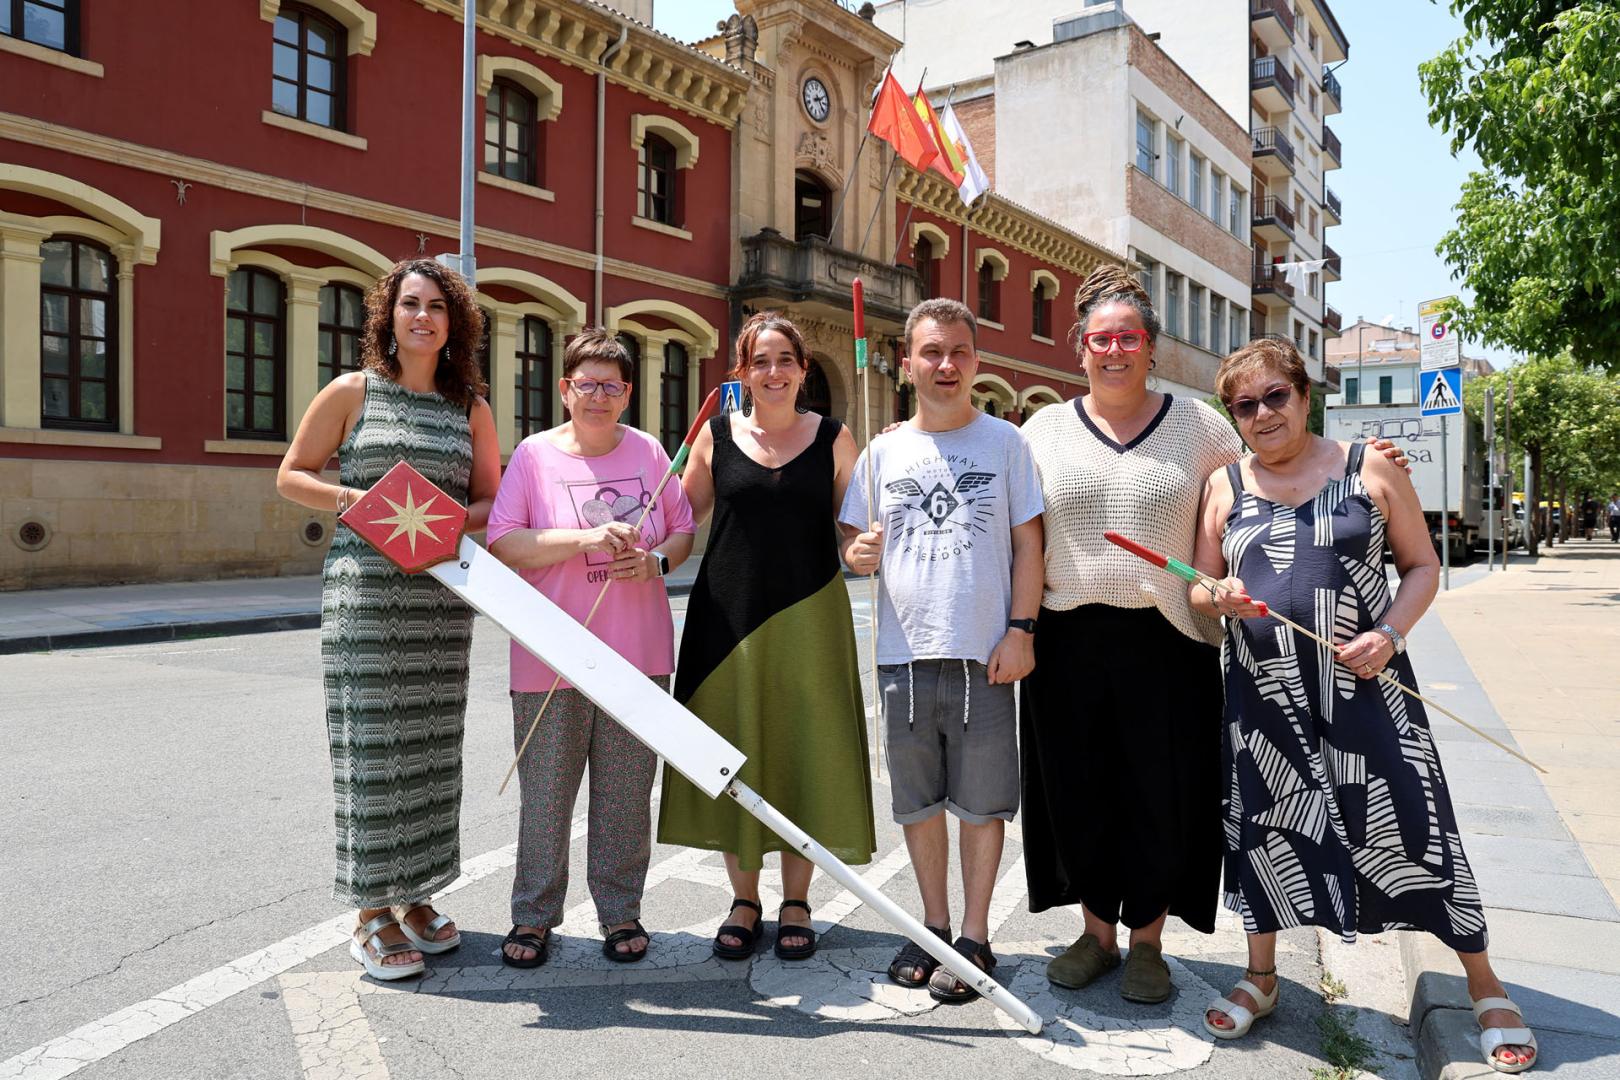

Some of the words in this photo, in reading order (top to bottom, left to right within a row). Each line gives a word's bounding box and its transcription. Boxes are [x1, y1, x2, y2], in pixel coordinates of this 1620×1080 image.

[905, 454, 978, 475] HIGHWAY
[1402, 448, 1433, 463] sa
[931, 491, 948, 518] 6
